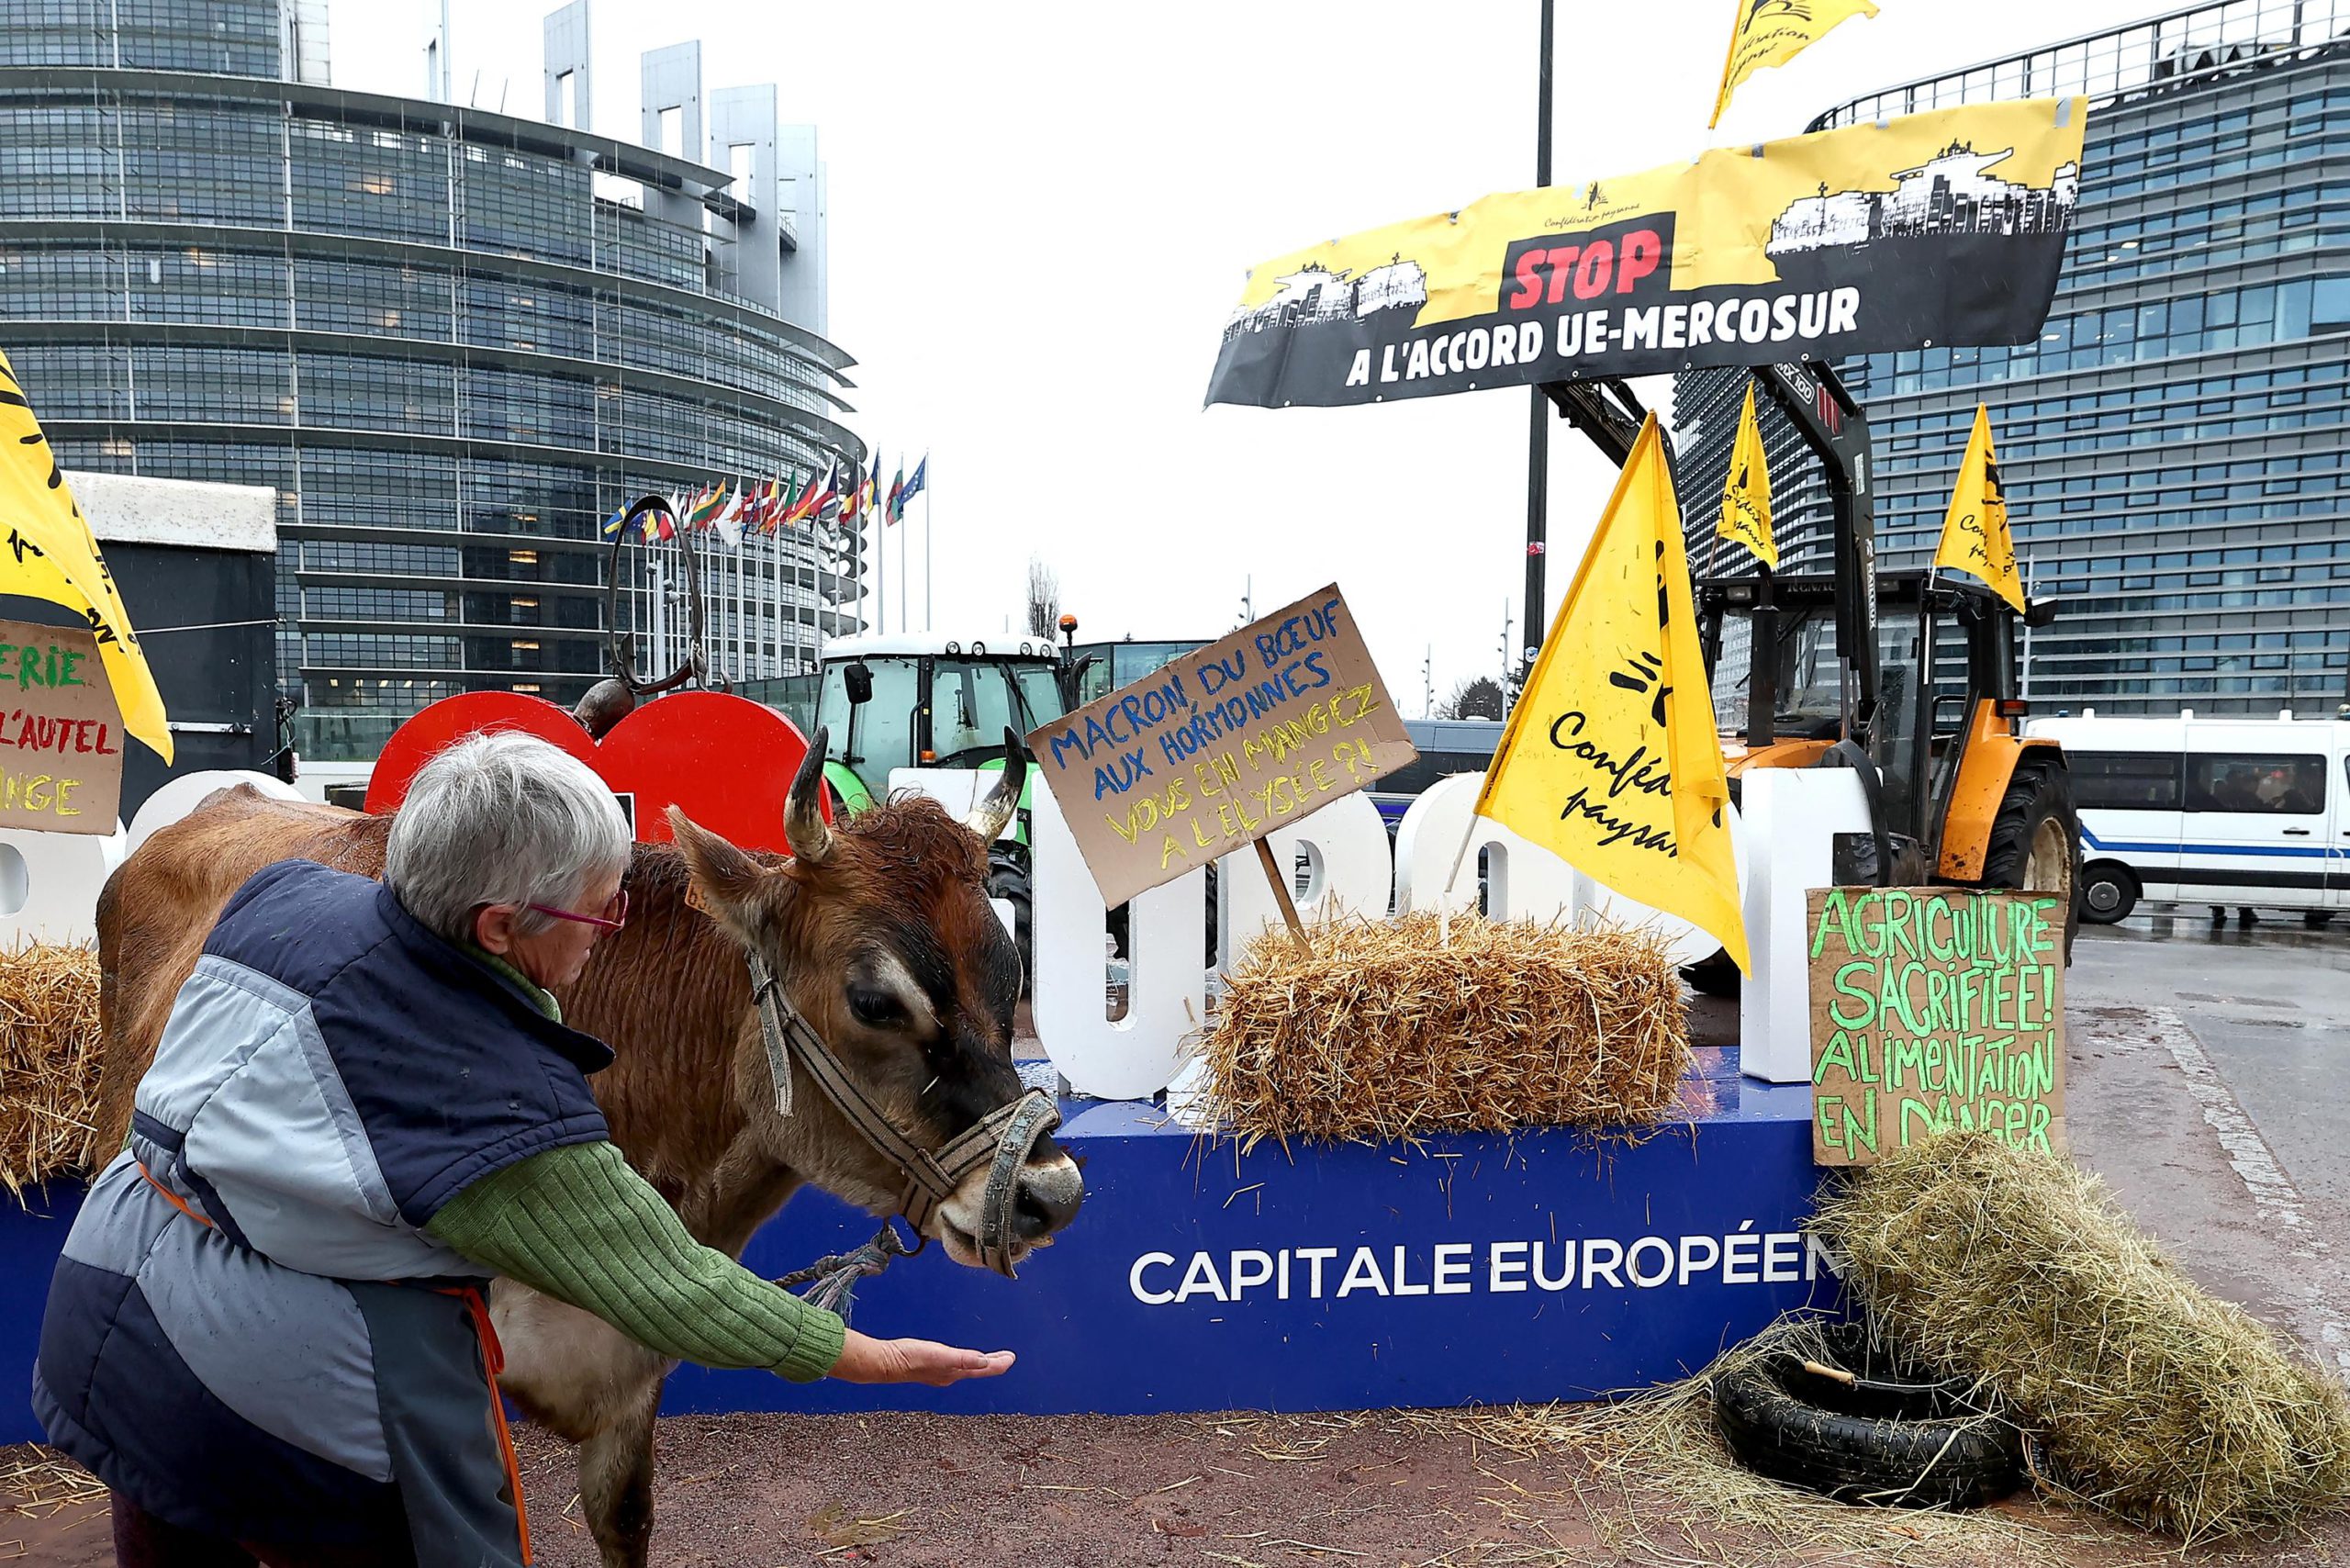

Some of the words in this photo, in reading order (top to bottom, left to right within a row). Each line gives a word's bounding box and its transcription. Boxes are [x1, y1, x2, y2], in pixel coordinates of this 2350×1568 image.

[1509, 229, 1662, 310] STOP
[1345, 347, 1371, 387] A
[1380, 320, 1544, 386] L'ACCORD
[1555, 286, 1861, 359] UE-MERCOSUR
[1794, 375, 1813, 399] 100
[1197, 649, 1246, 696] DU
[1254, 599, 1340, 669] BŒUF
[1094, 746, 1153, 801] AUX
[1158, 651, 1330, 766] HORMONNES
[1105, 777, 1192, 846] VOUS
[1194, 751, 1241, 799] EN
[1242, 682, 1382, 771] MANGEZ
[1817, 1087, 1878, 1160] EN
[1128, 1242, 1472, 1305] CAPITALE
